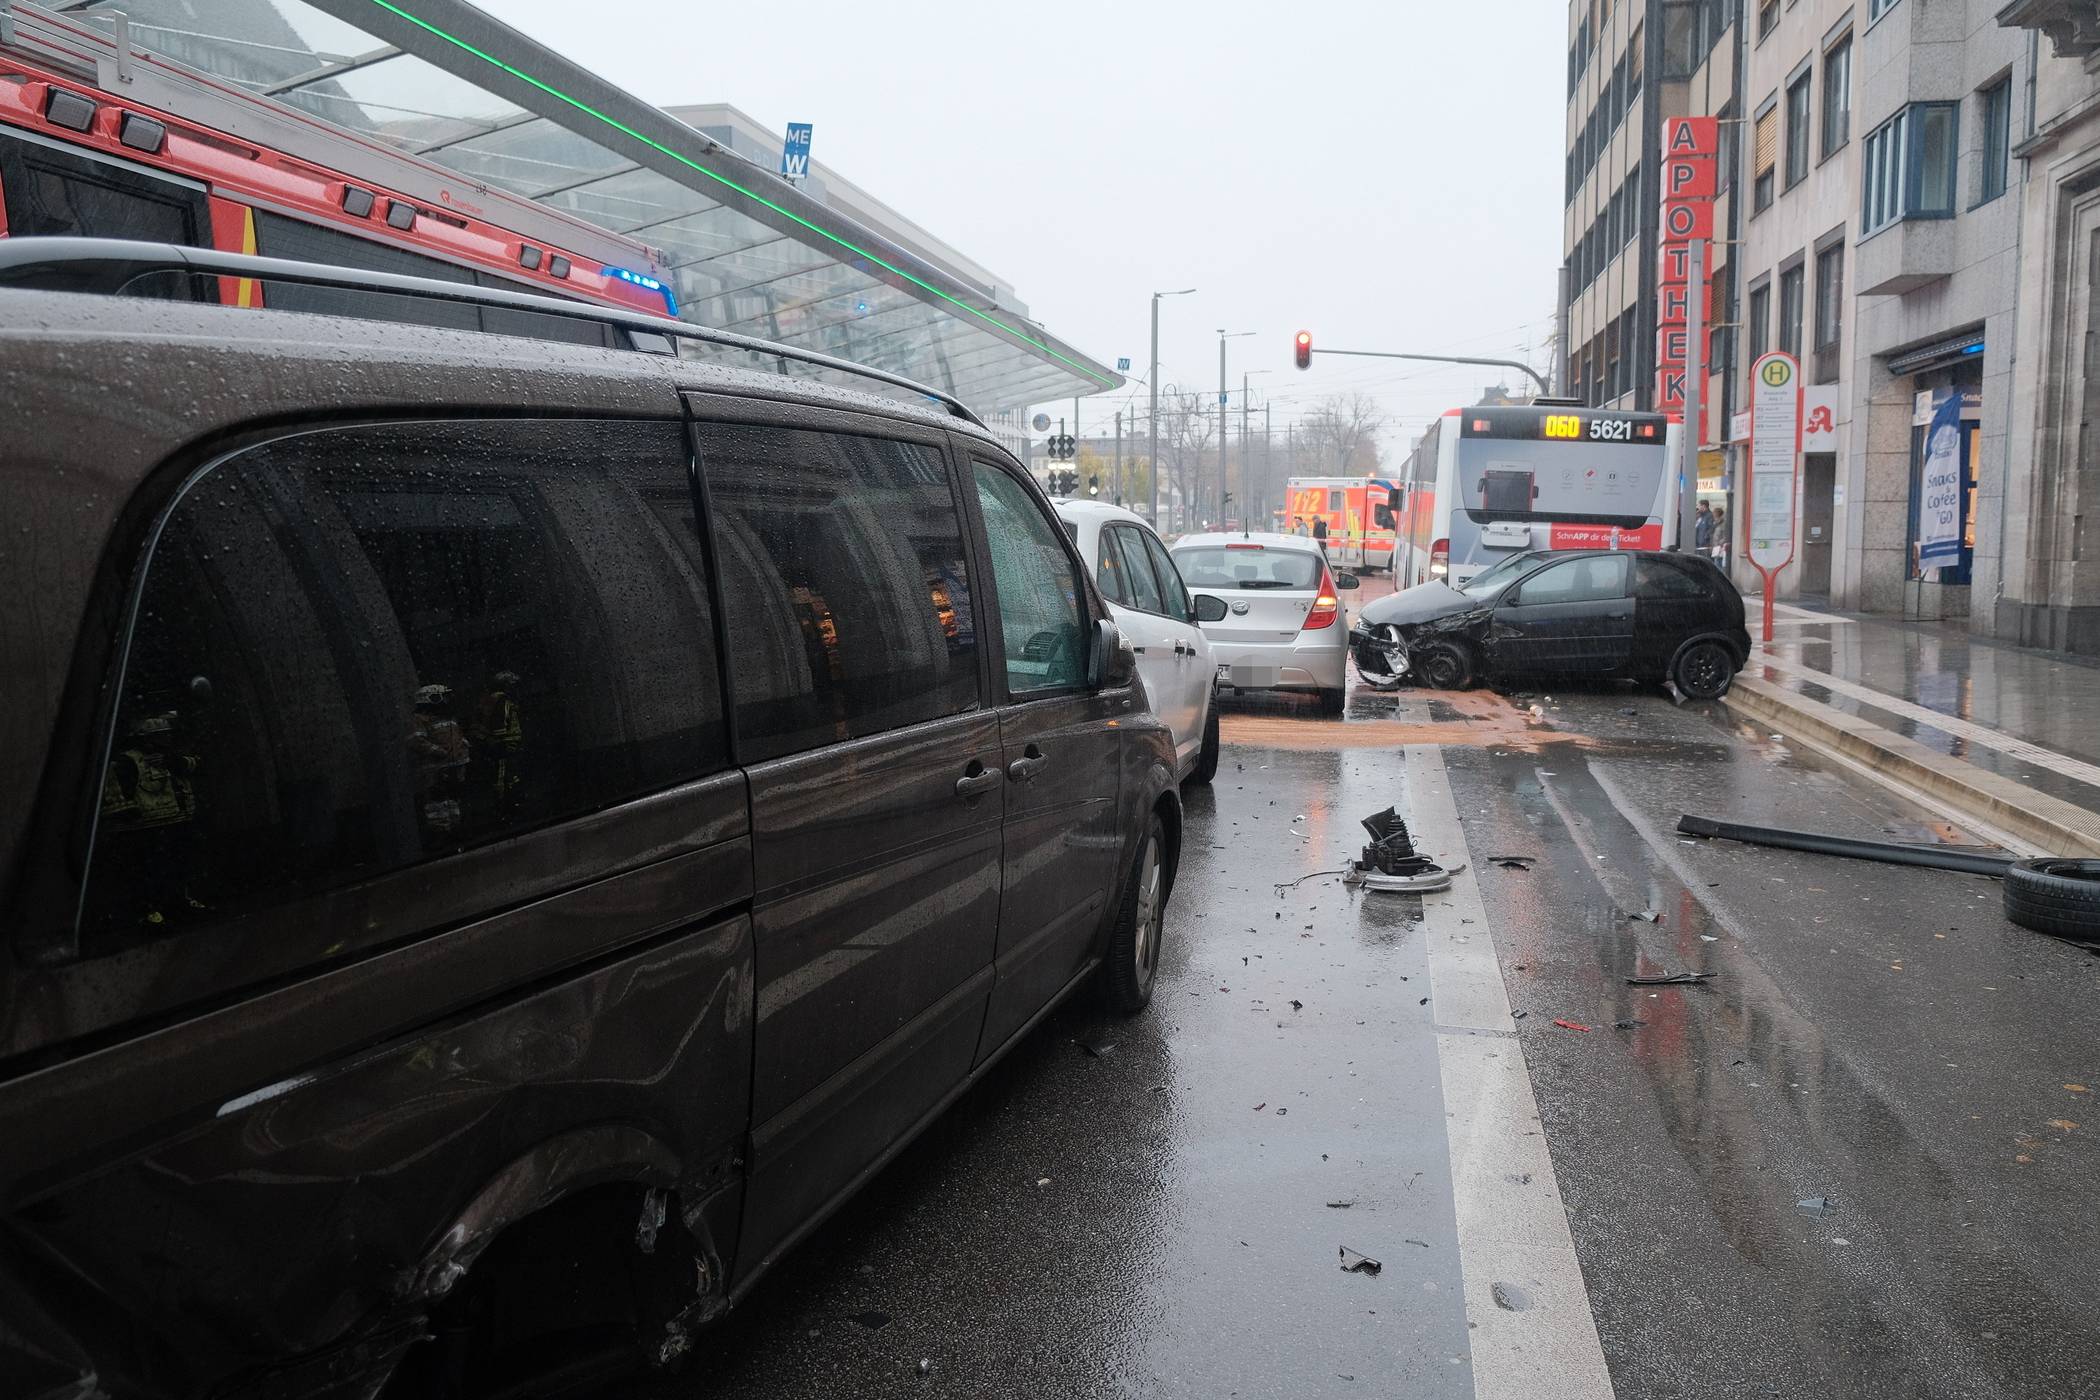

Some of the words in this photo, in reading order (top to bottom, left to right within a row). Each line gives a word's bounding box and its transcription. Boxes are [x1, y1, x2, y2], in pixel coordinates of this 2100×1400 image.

[786, 129, 811, 145] ME
[785, 153, 807, 174] W
[1666, 120, 1697, 401] APOTHEK
[1770, 365, 1783, 381] H
[1545, 415, 1580, 438] 060
[1589, 419, 1632, 440] 5621
